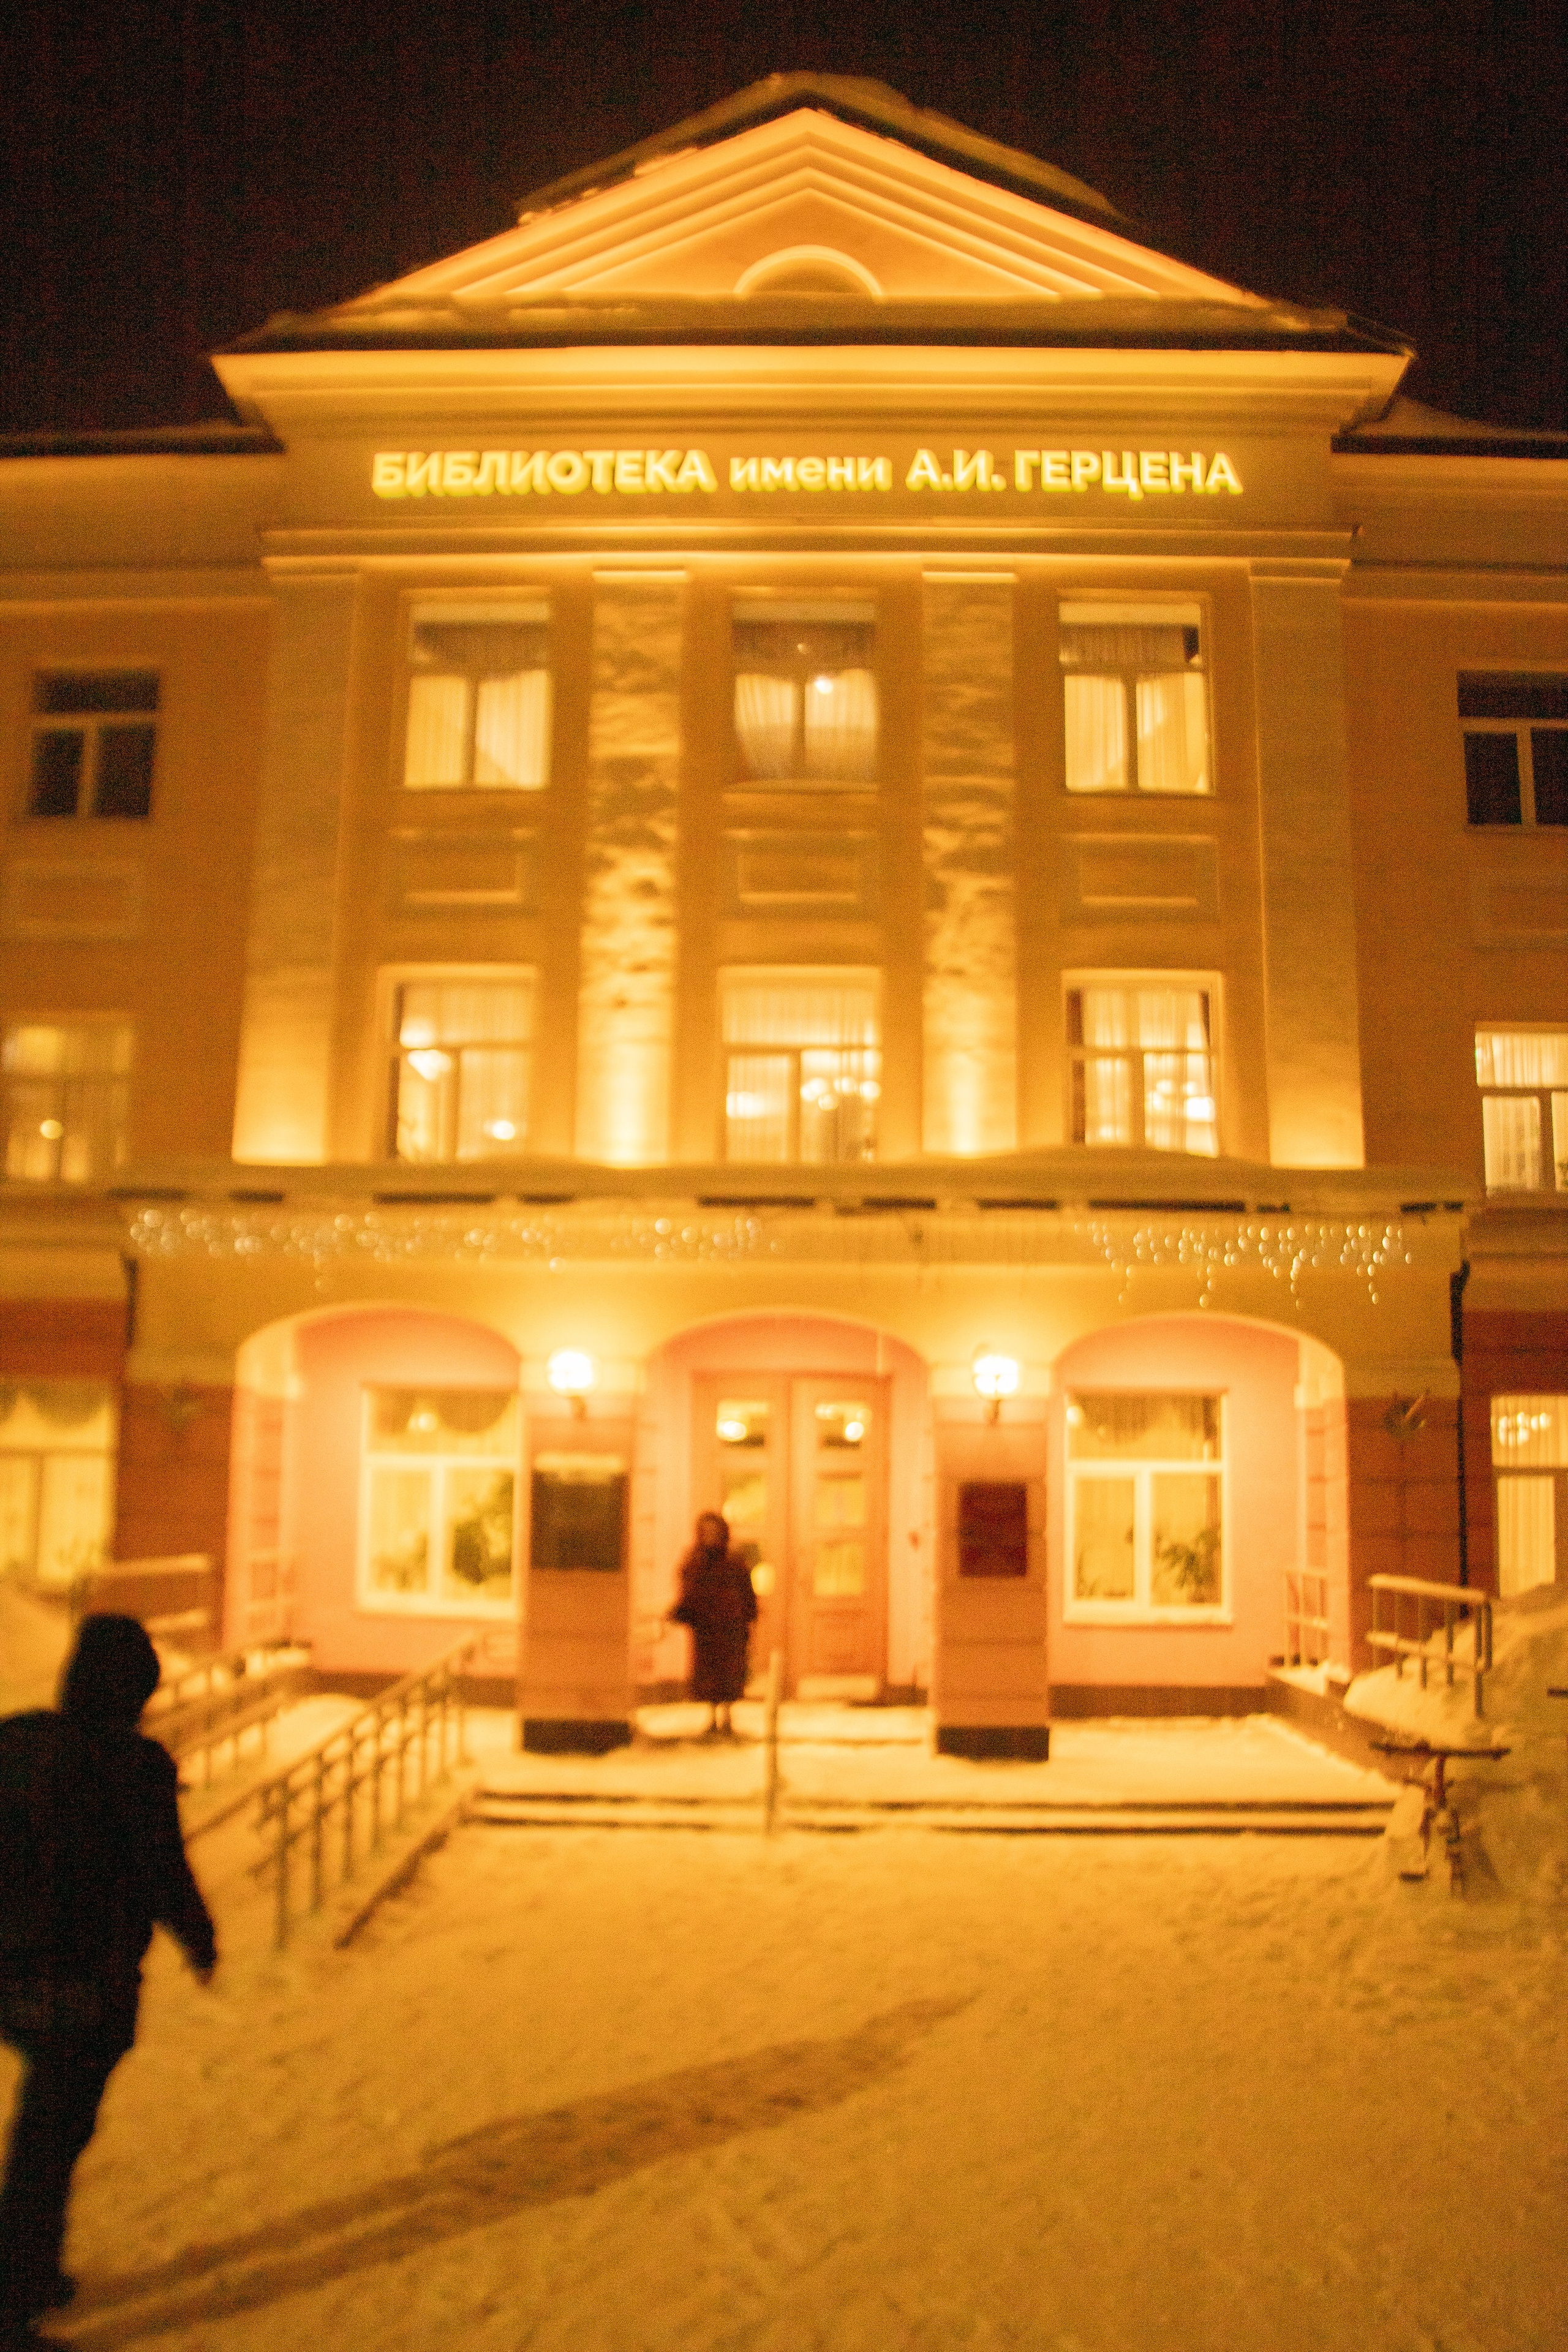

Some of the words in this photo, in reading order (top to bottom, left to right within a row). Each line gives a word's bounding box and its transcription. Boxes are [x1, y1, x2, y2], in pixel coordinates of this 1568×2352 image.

[372, 450, 717, 496] БИБЛИОТЕКА
[729, 456, 892, 491] имени
[906, 449, 1006, 491] А.И.
[1015, 450, 1243, 500] ГЕРЦЕНА
